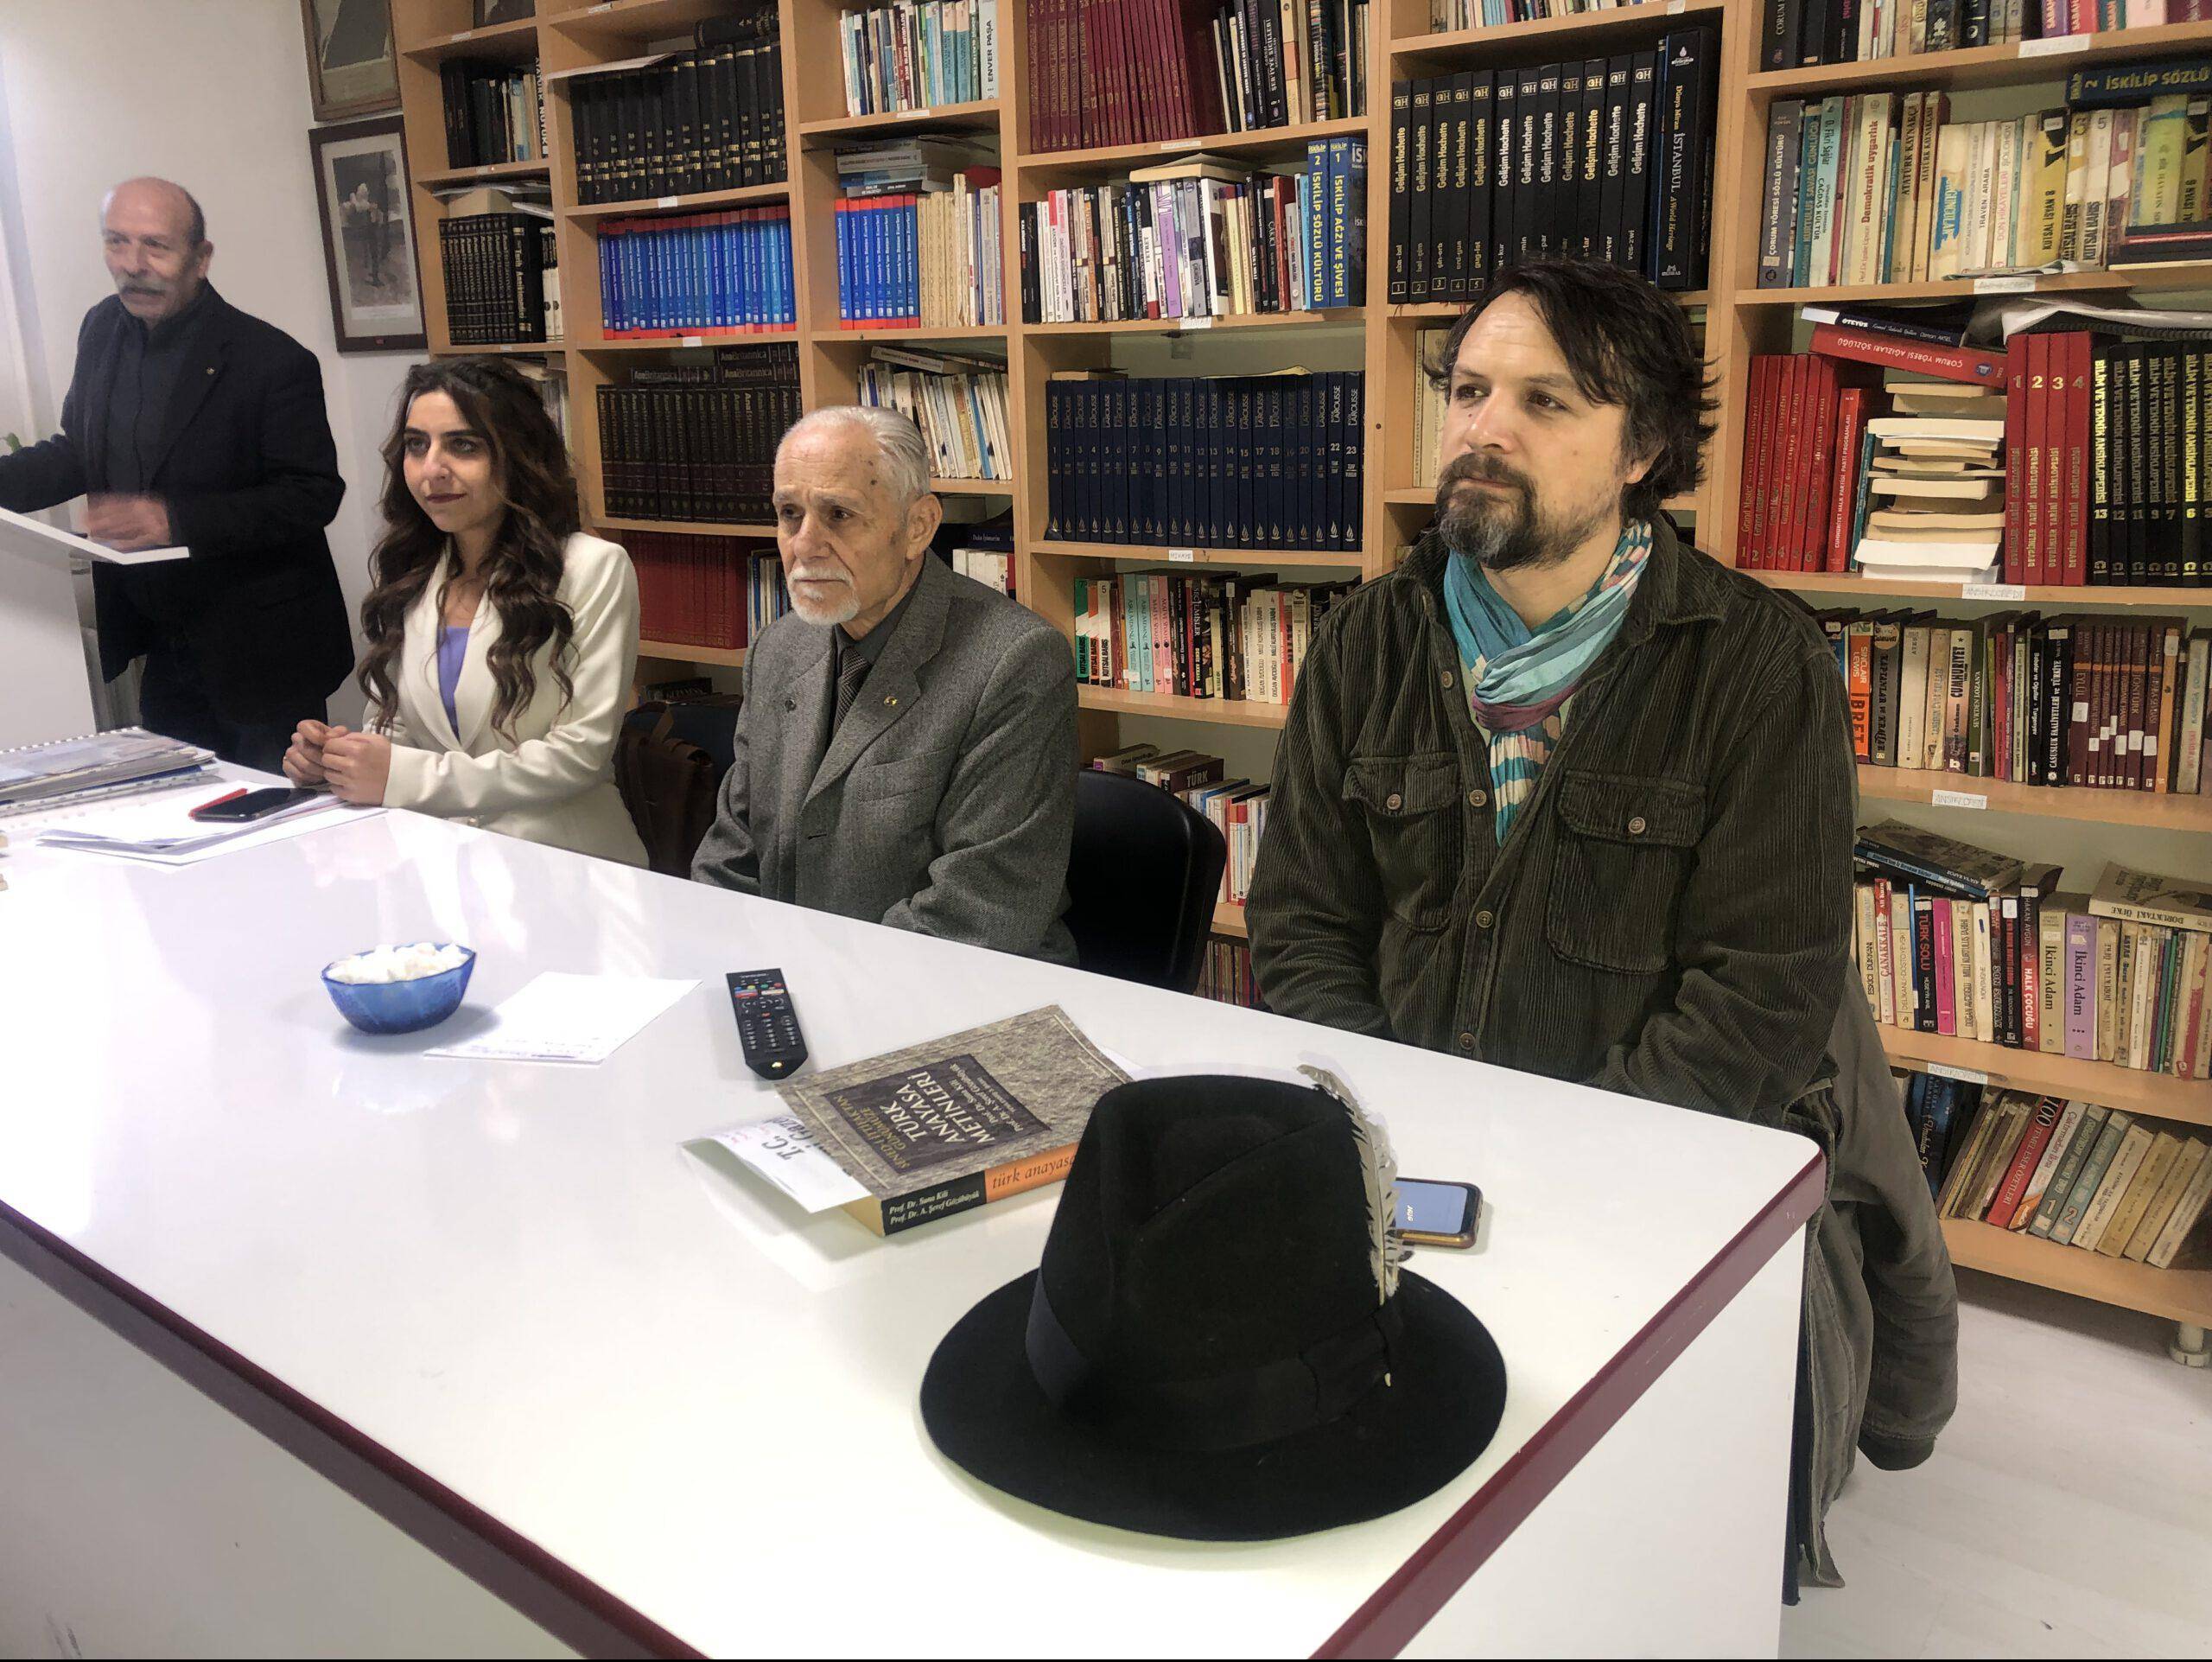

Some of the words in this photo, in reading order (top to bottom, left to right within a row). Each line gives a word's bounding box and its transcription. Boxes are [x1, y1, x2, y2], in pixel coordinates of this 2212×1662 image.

[985, 20, 994, 46] PAŞA
[2106, 72, 2158, 91] İSKİLİP
[538, 106, 548, 144] NUTUK
[1500, 118, 1510, 155] Hachette
[1522, 115, 1533, 151] Hachette
[1541, 112, 1553, 150] Hachette
[1563, 111, 1574, 148] Hachette
[1586, 110, 1598, 147] Hachette
[1609, 105, 1621, 143] Hachette
[1633, 103, 1646, 140] Hachette
[1824, 129, 1834, 144] Fikri
[1774, 134, 1784, 169] KÜLTÜRÜ
[1822, 145, 1834, 165] Sağlar
[1867, 120, 1878, 162] uygarlık
[1475, 156, 1486, 186] Gelişim
[1498, 156, 1510, 186] Gelişim
[1521, 153, 1534, 183] Gelişim
[1541, 150, 1554, 182] Gelişim
[1562, 150, 1575, 181] Gelişim
[1585, 149, 1598, 180] Gelişim
[1608, 144, 1621, 176] Gelişim
[1631, 142, 1645, 173] Gelişim
[1670, 132, 1685, 193] İSTANBUL
[1921, 151, 1930, 181] ATATÜRK
[1437, 159, 1448, 188] Gelişim
[1772, 170, 1781, 196] SÖZLÜ
[1901, 156, 1912, 195] ATATÜRK
[1982, 169, 1991, 194] ARABA
[1997, 221, 2005, 240] DON
[2001, 125, 2011, 166] ŞOLOHOV
[1313, 172, 1323, 211] İSKİLİP
[1334, 175, 1344, 214] İSKİLİP
[1815, 177, 1824, 207] ÇAĞDAŞ
[1861, 164, 1876, 223] Demokratik
[1770, 197, 1780, 225] YÖRESİ
[1979, 199, 1987, 228] TRAVEN
[2044, 199, 2054, 220] İSYAN
[1313, 213, 1323, 249] SÖZLÜ
[1335, 218, 1344, 243] AĞZI
[1814, 210, 1822, 240] KÜLTÜR
[2042, 223, 2052, 250] KUTSAL
[1335, 245, 1343, 260] VE
[1769, 227, 1778, 256] ÇORUM
[2082, 228, 2096, 260] KUTSAL
[1313, 252, 1323, 302] KÜLTÜRÜ
[1333, 263, 1344, 297] ŞİVESİ
[1838, 338, 1872, 351] SÖZLÜĞÜ
[1876, 345, 1905, 358] AĞIZLARI
[1906, 351, 1933, 364] YÖRESİ
[1936, 357, 1963, 368] ÇORUM
[2094, 360, 2107, 387] BİLİM
[2185, 354, 2198, 380] BİLİM
[2013, 376, 2022, 388] 1
[2031, 375, 2044, 388] 2
[2052, 376, 2063, 389] 3
[2073, 375, 2084, 388] 4
[2094, 388, 2107, 400] VE
[2185, 383, 2197, 397] VE
[2094, 401, 2107, 436] TEKNİK
[2185, 397, 2197, 433] TEKNİK
[1169, 445, 1178, 454] 10
[1184, 445, 1191, 454] 11
[1331, 443, 1340, 451] 22
[1842, 414, 1851, 455] PROGRAMLARI
[1270, 447, 1280, 455] 18
[1300, 446, 1309, 455] 20
[1317, 447, 1325, 455] 21
[1346, 446, 1357, 455] 23
[2028, 447, 2038, 499] ANSİKLOPEDİSİ
[2049, 447, 2059, 499] ANSİKLOPEDİSİ
[2094, 437, 2107, 504] ANSİKLOPEDİSİ
[2185, 434, 2199, 502] ANSİKLOPEDİSİ
[1838, 474, 1847, 495] PARTİSİ
[2027, 502, 2037, 526] TARİHİ
[2048, 502, 2057, 526] TARİHİ
[2094, 509, 2107, 519] 13
[2186, 508, 2196, 518] 6
[1834, 513, 1844, 548] CUMHURİYET
[2026, 529, 2037, 567] DEVRİMLER
[2047, 529, 2057, 568] DEVRİMLER
[1878, 654, 1889, 704] KAPTANLAR
[2051, 660, 2062, 686] TÜRKİYE
[2075, 672, 2087, 697] EYLÜL
[2050, 696, 2060, 735] FAALİYETLERİ
[1919, 914, 1930, 940] TÜRK
[1878, 921, 1891, 977] ÇANAKKALE
[1920, 942, 1930, 971] SOLU
[1961, 937, 1970, 964] KURTULUŞ
[2044, 946, 2057, 976] İkinci
[1961, 965, 1970, 977] MİLLİ
[1993, 965, 2001, 986] SON
[2074, 951, 2088, 982] İkinci
[2044, 978, 2056, 1010] Adam
[2073, 984, 2086, 1016] Adam
[2024, 992, 2034, 1028] ÇOCUĞU
[880, 1100, 928, 1142] TÜRK
[896, 1084, 969, 1143] ANAYASA
[907, 1071, 995, 1143] METİNLERİ
[2036, 1097, 2060, 1128] 100
[992, 1168, 1020, 1189] türk
[2003, 1167, 2026, 1206] ÖZETLERİ
[889, 1202, 906, 1214] Prof.
[906, 1200, 918, 1209] Dr.
[918, 1195, 936, 1206] Suna
[936, 1189, 949, 1200] Kili
[890, 1213, 907, 1225] Prof.
[908, 1210, 919, 1219] Dr.
[928, 1201, 946, 1215] Şeref
[2064, 1207, 2078, 1225] 2
